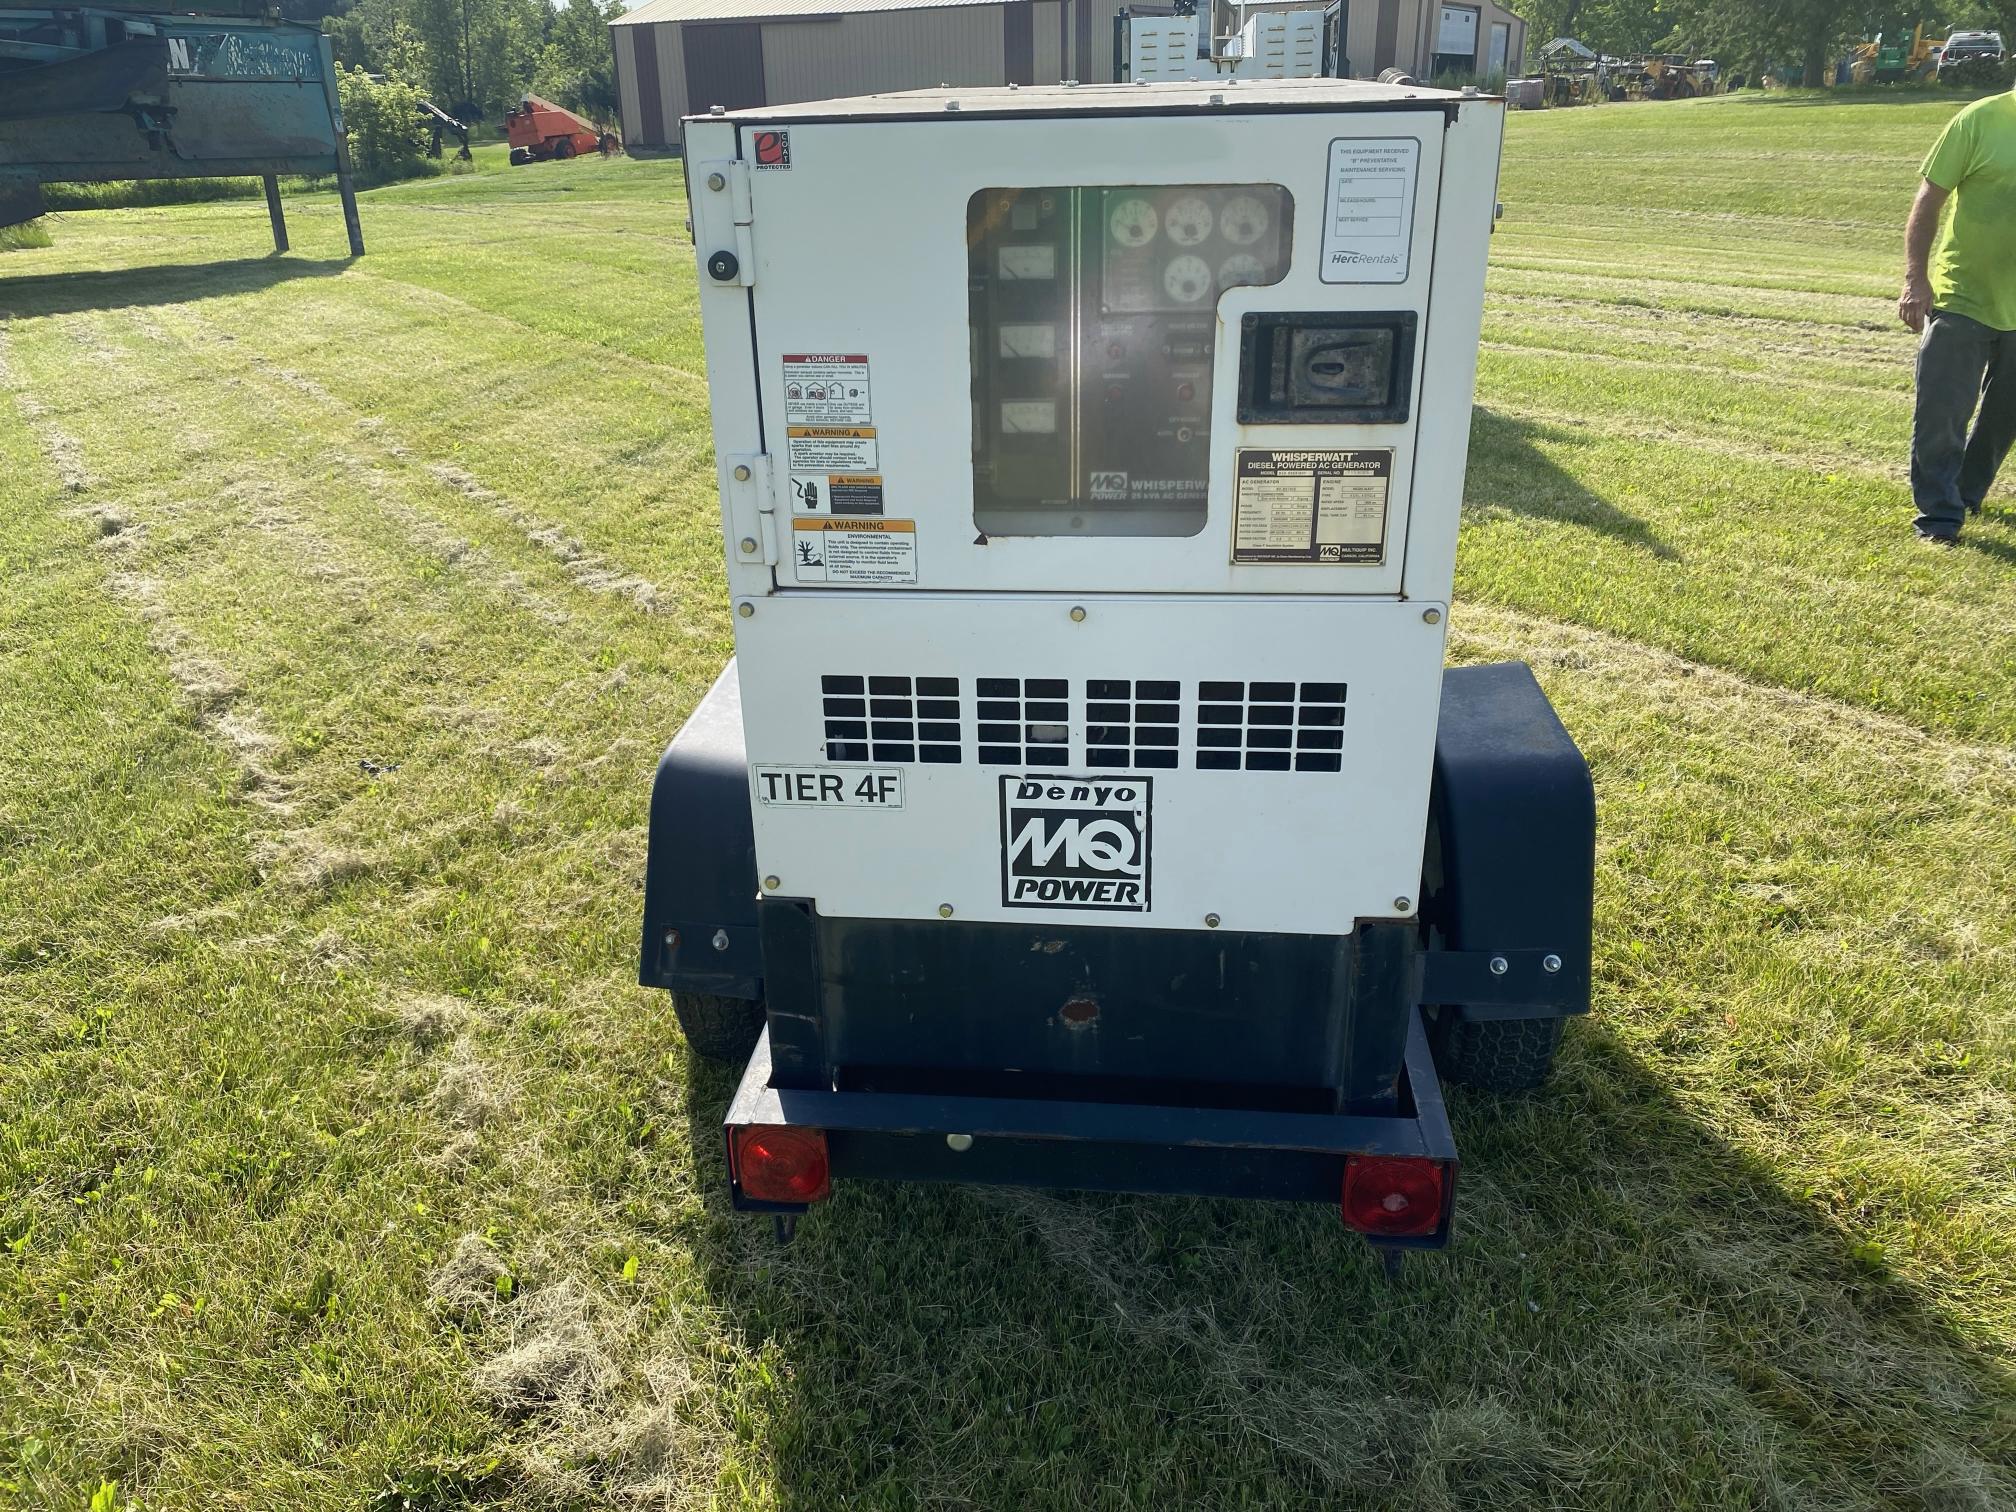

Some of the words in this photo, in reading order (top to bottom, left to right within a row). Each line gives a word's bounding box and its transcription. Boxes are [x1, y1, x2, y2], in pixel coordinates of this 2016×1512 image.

[1331, 252, 1399, 264] HercRentals
[811, 355, 846, 363] DANGER
[1271, 452, 1353, 461] WHISPERWATT
[1247, 461, 1276, 469] DIESEL
[1276, 461, 1318, 469] POWERED
[1318, 461, 1330, 469] AC
[1331, 461, 1381, 469] GENERATOR
[834, 521, 885, 530] WARNING
[1319, 547, 1341, 556] MQ
[760, 773, 845, 802] TIER
[854, 774, 898, 803] 4F
[1016, 782, 1137, 806] Denyo
[1007, 817, 1142, 875] MQ
[1013, 878, 1140, 904] POWER
